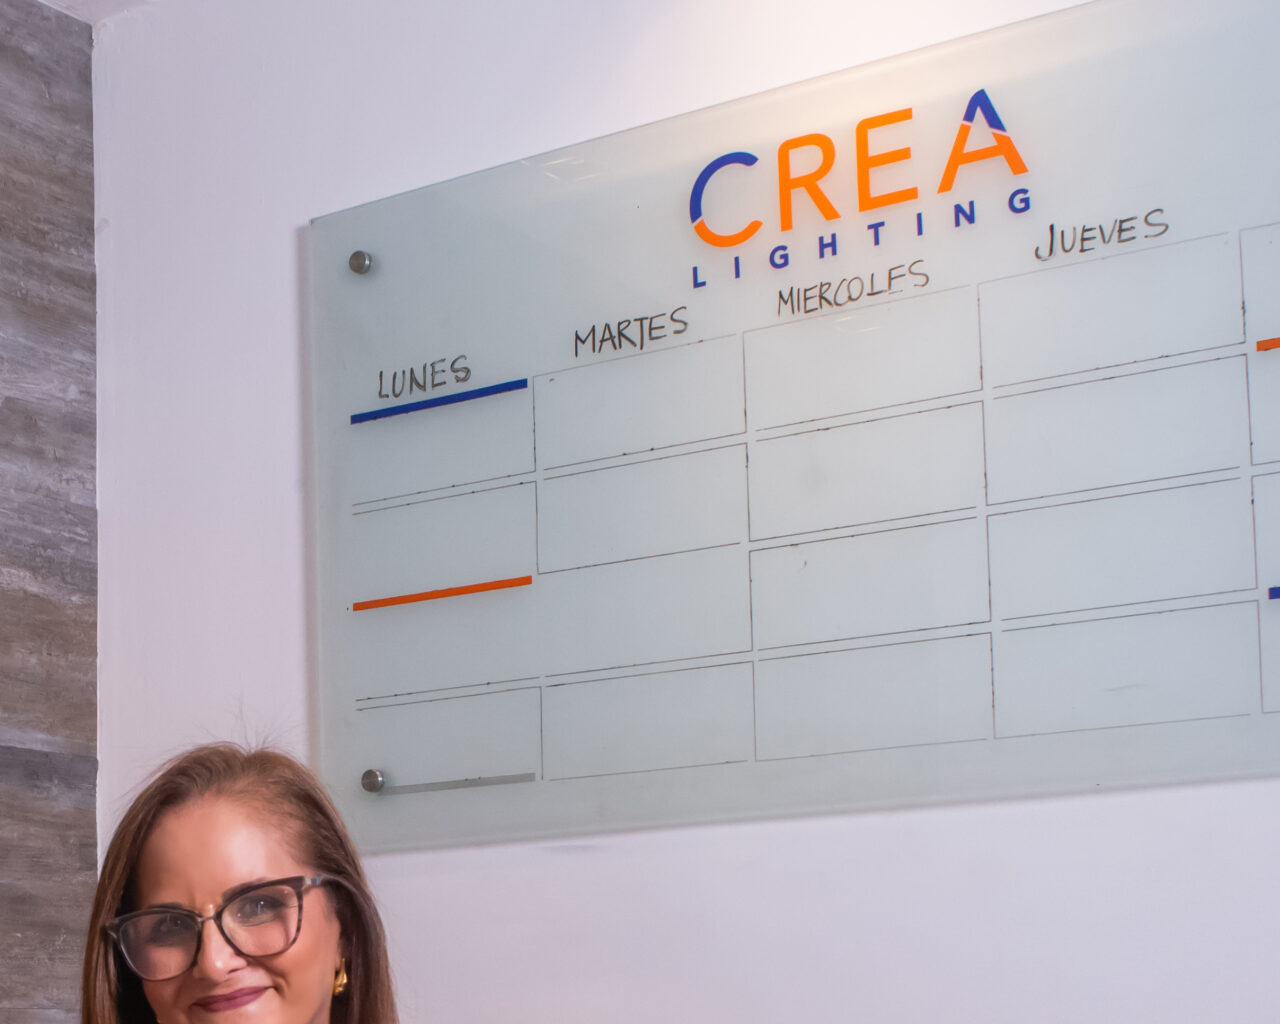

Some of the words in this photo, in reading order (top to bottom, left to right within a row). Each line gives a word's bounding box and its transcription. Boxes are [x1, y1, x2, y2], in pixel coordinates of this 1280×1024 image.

[689, 88, 1029, 248] CREA
[692, 188, 1032, 288] LIGHTING
[1034, 208, 1170, 261] JUEVES
[574, 306, 689, 358] MARTES
[378, 355, 472, 399] LUNES
